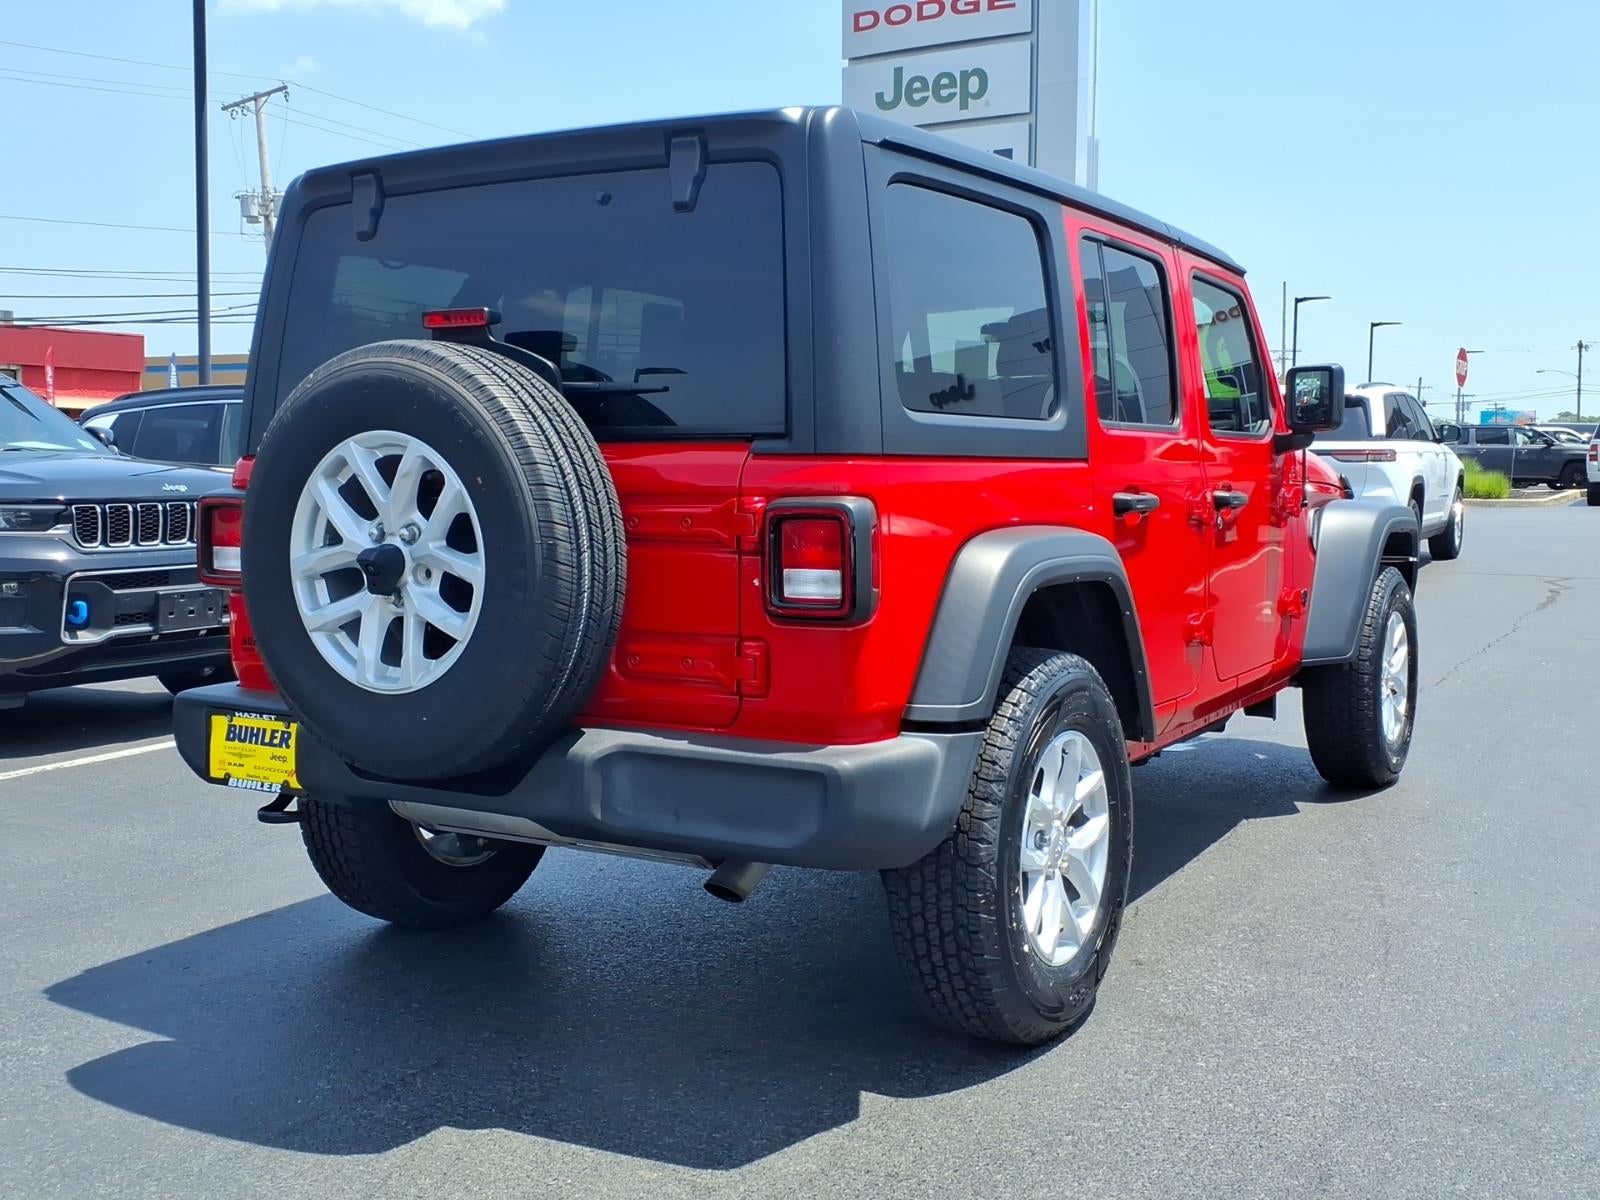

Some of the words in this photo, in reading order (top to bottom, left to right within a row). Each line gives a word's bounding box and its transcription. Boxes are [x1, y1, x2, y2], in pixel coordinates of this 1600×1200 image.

[875, 67, 988, 111] Jeep
[1456, 360, 1467, 376] STOP
[234, 711, 277, 721] HAZLET
[225, 723, 292, 749] BUHLER
[269, 753, 288, 764] Jeep
[228, 777, 282, 793] BUHLER
